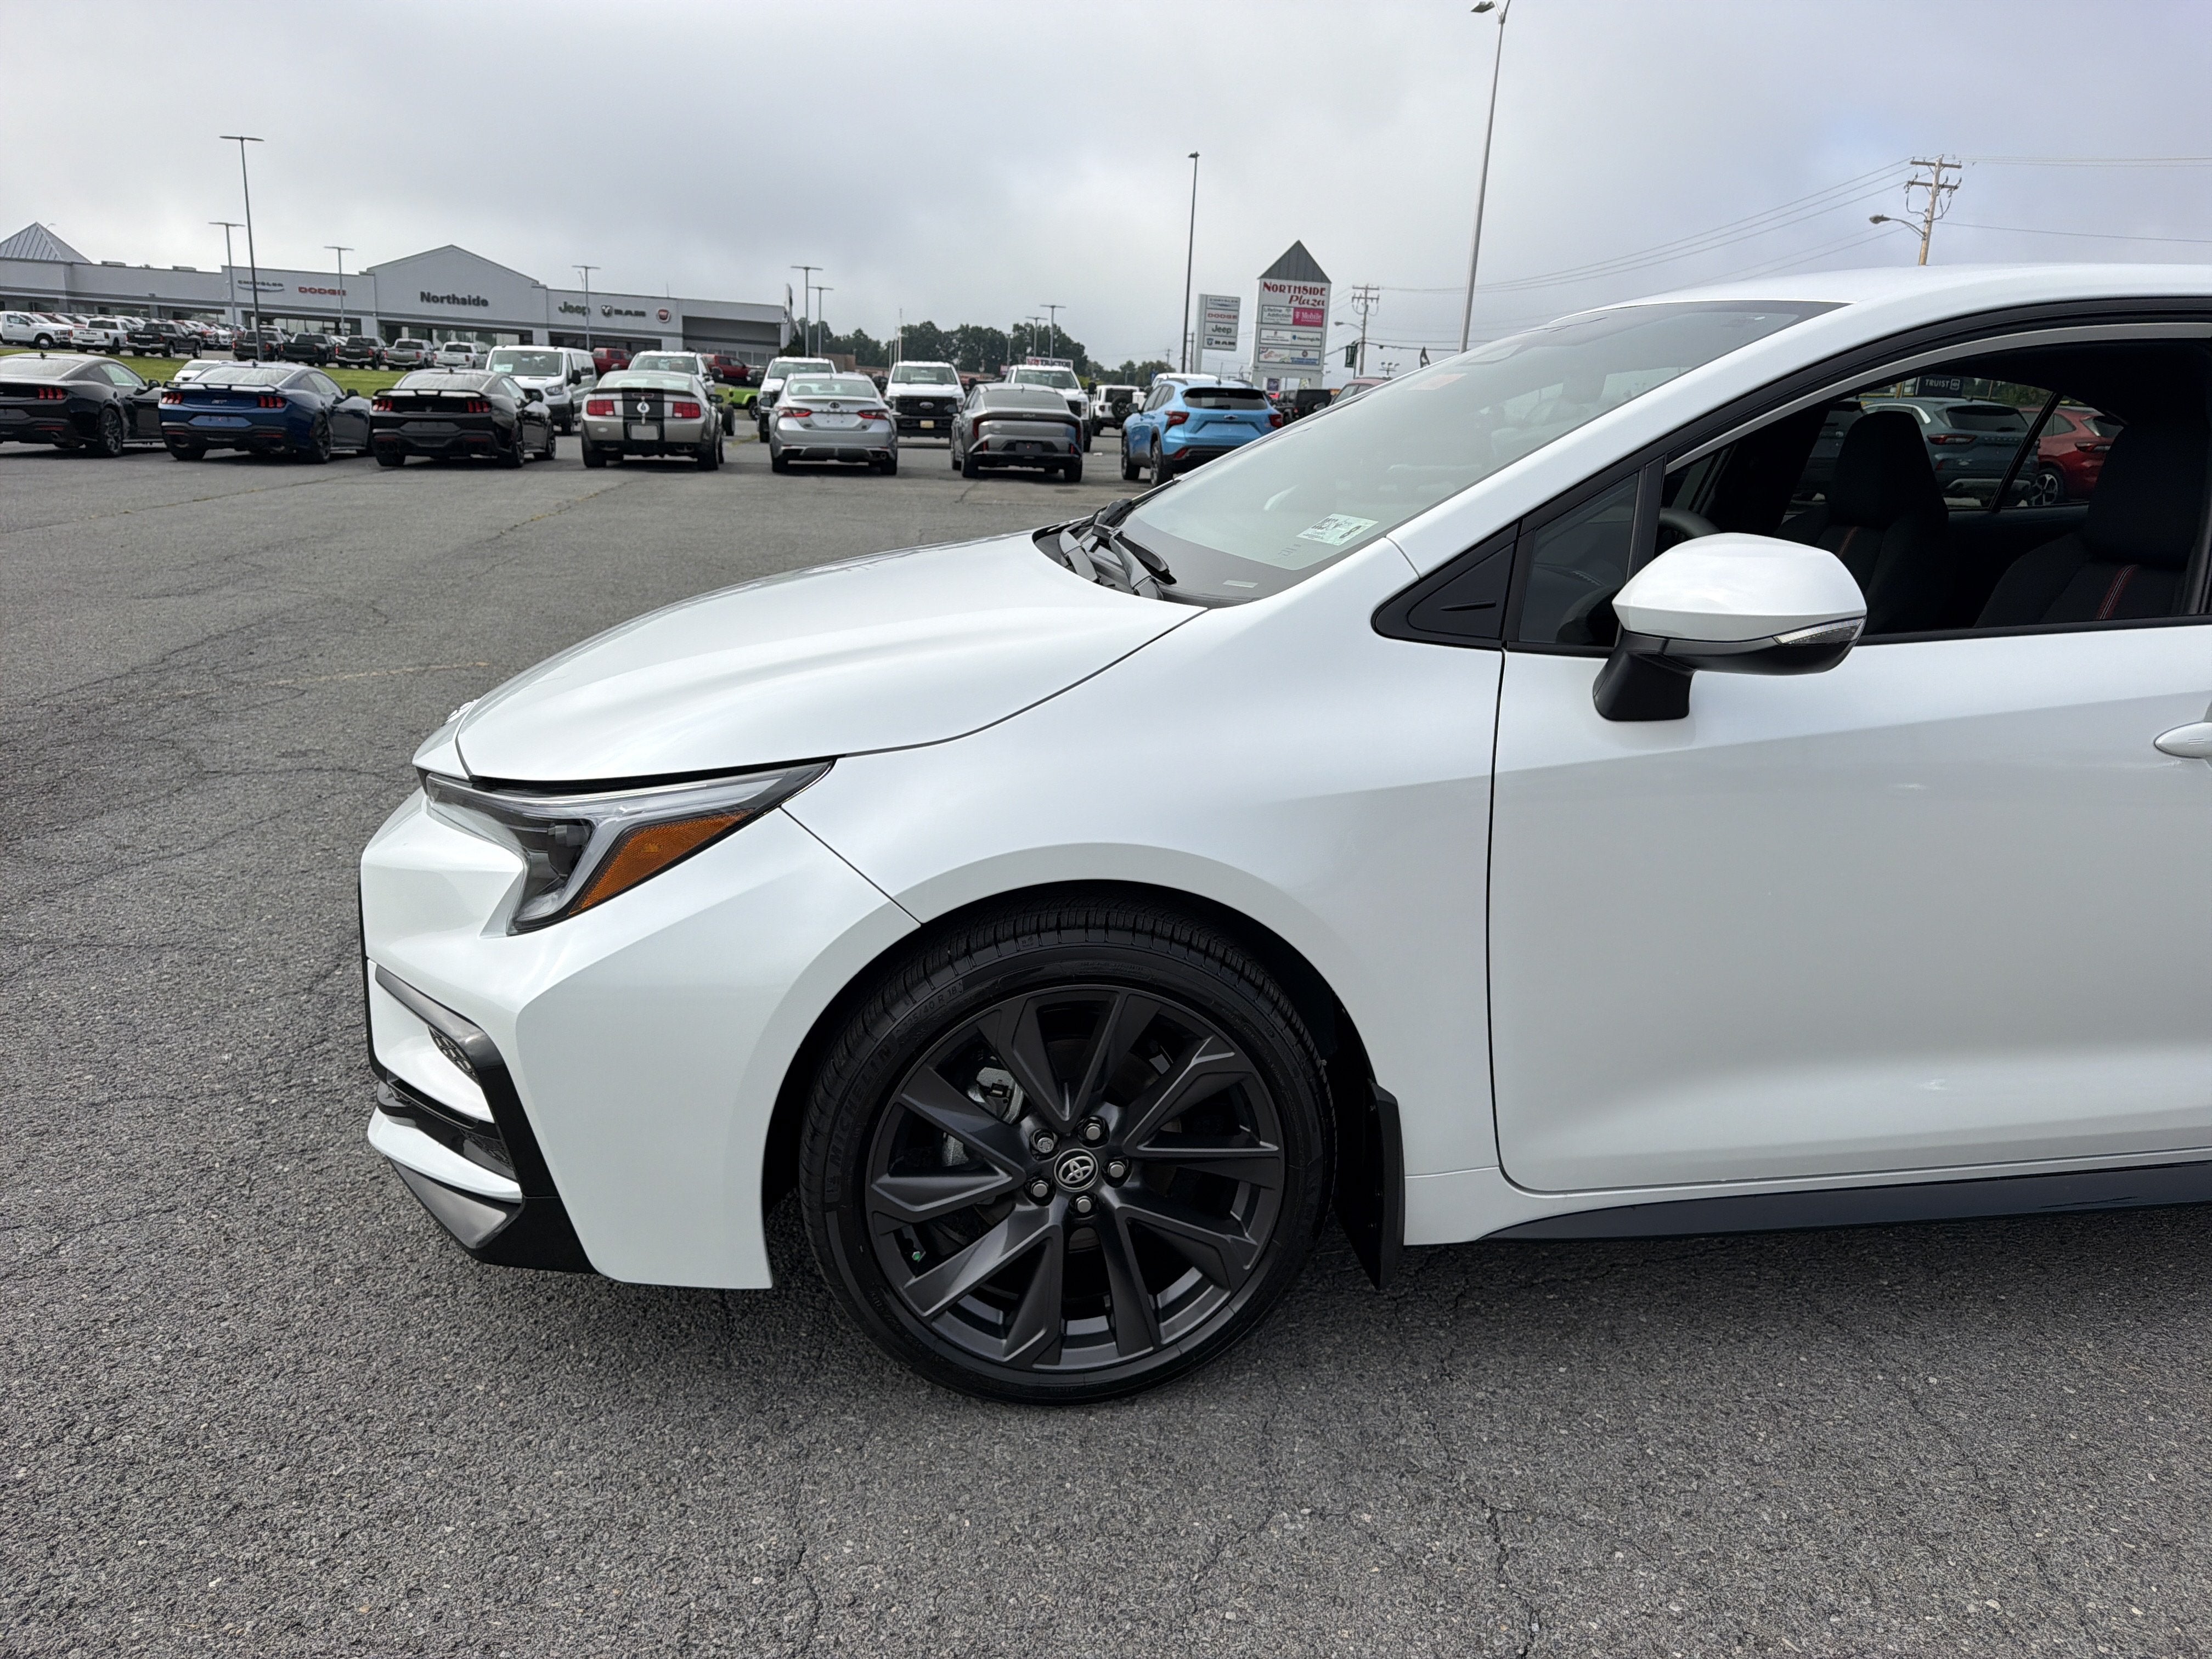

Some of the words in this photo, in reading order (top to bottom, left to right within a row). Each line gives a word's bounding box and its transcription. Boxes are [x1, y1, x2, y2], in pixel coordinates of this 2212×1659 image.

[1263, 281, 1326, 296] NORTHSIDE
[420, 291, 489, 307] Northside
[1289, 295, 1325, 307] Plaza
[1211, 324, 1232, 334] Jeep
[1926, 379, 1950, 389] TRUIST
